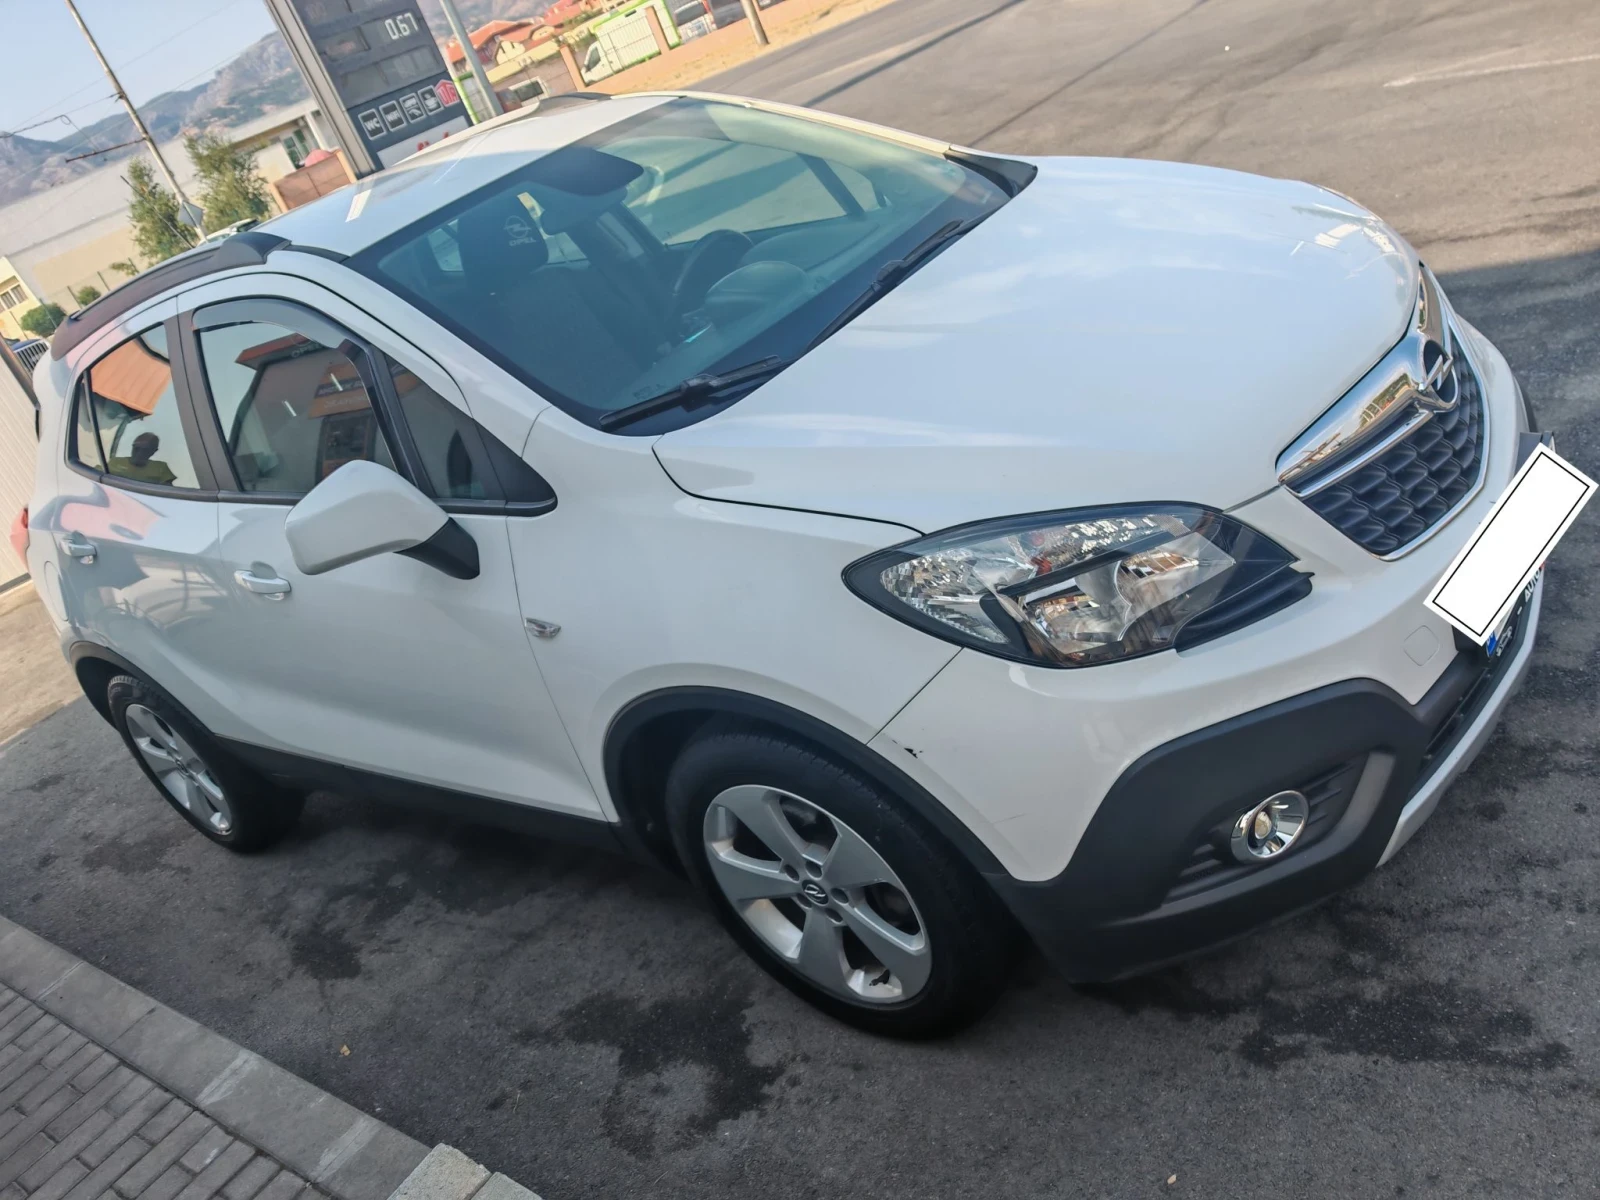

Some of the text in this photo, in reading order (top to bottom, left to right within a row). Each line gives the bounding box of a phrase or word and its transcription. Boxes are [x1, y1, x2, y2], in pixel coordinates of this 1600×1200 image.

[384, 12, 419, 40] 0.67
[363, 117, 381, 132] WC
[509, 237, 537, 246] OPEL
